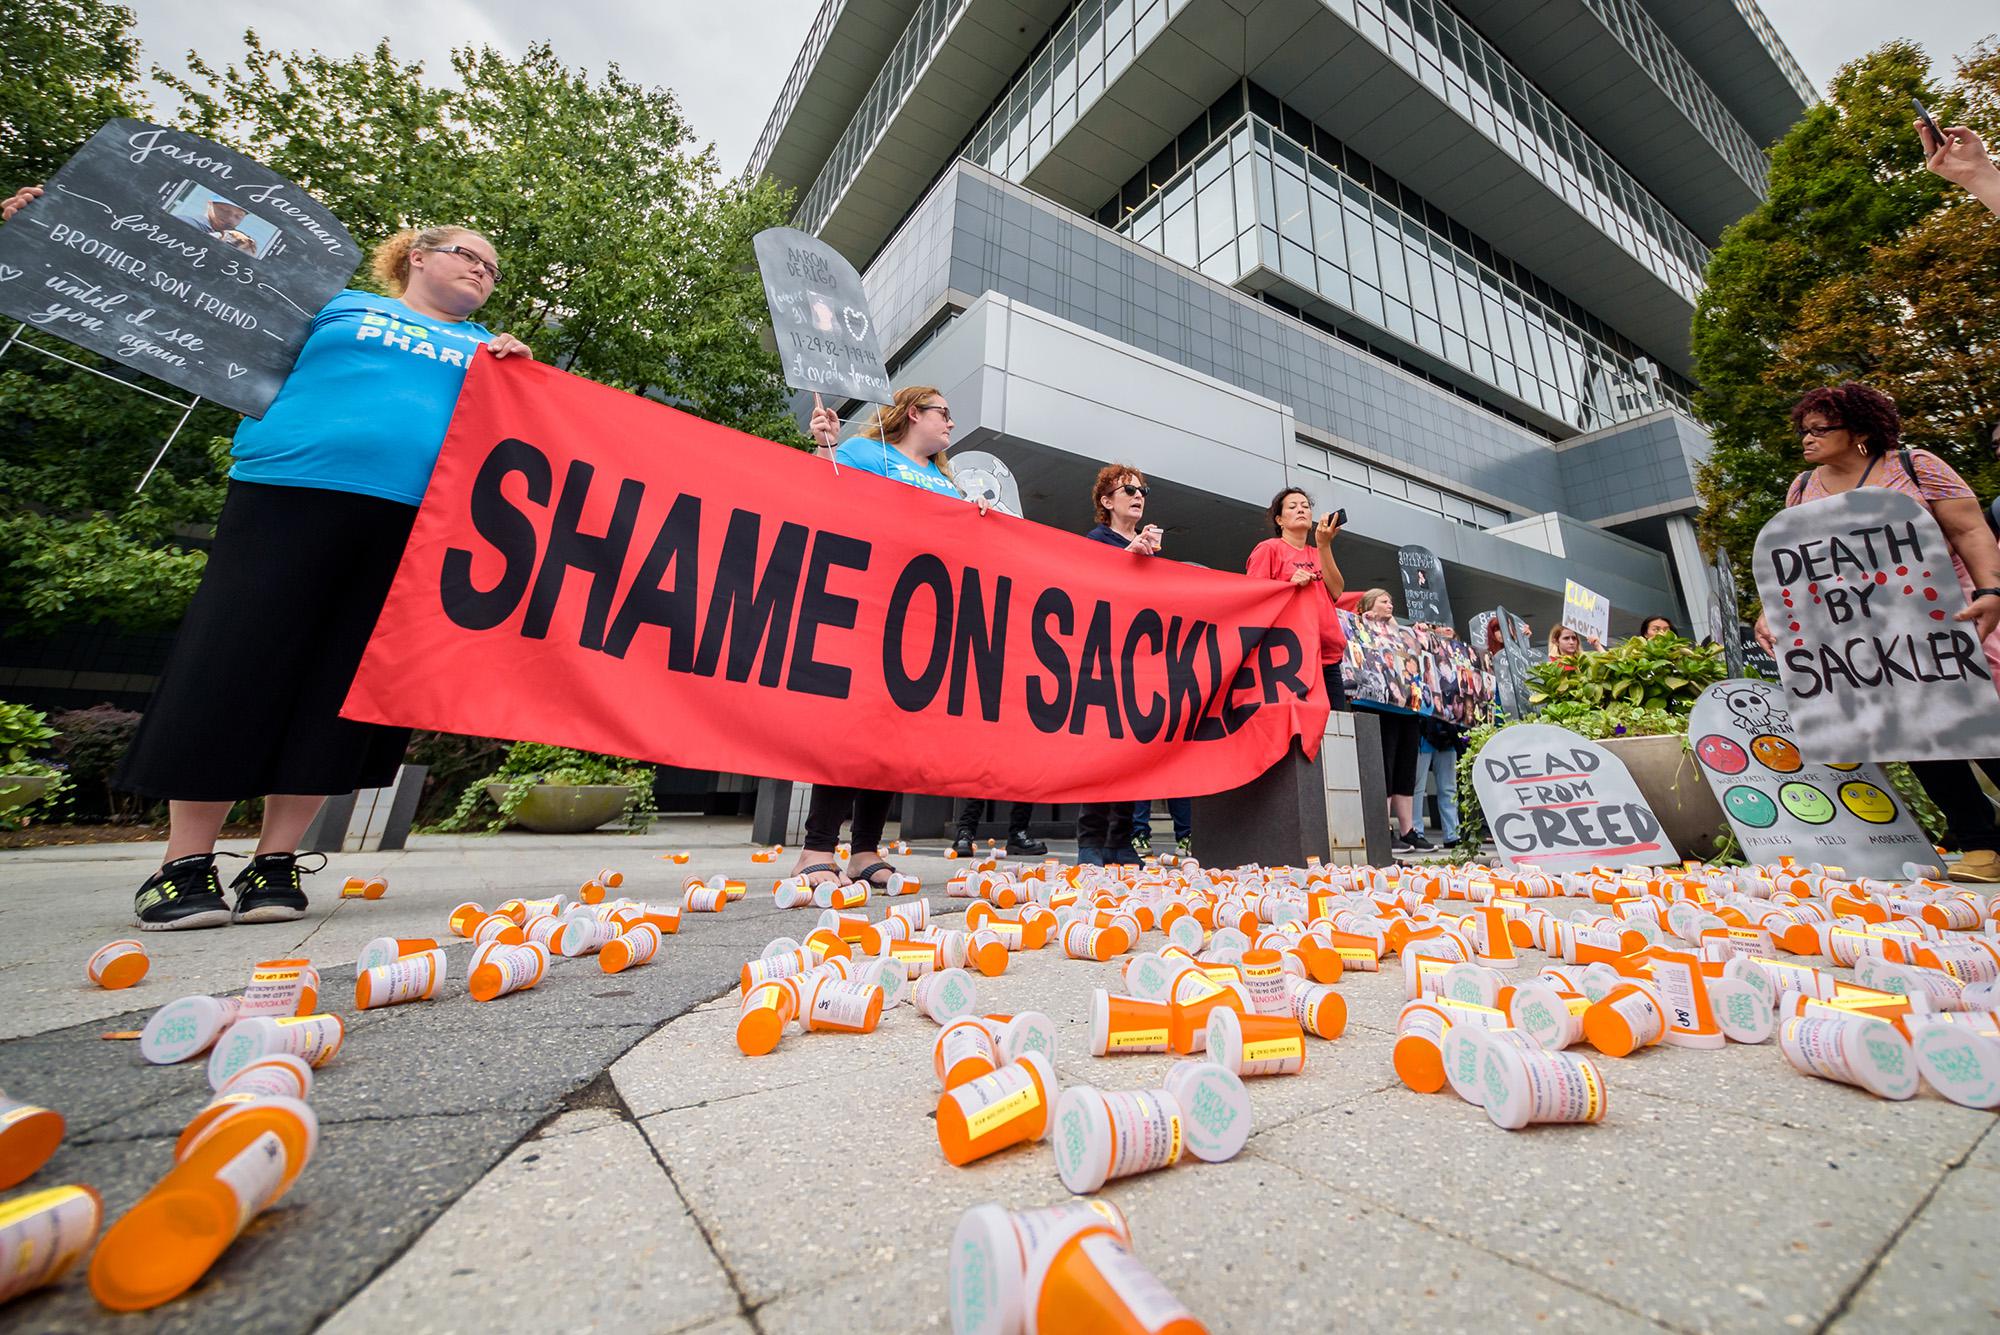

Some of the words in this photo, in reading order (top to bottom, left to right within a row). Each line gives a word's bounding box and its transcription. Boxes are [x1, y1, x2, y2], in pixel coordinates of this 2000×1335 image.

[128, 130, 233, 180] Jason
[111, 213, 209, 268] forever
[219, 259, 254, 285] 33
[786, 247, 830, 272] AARON
[49, 223, 147, 283] BROTHER,
[150, 270, 192, 304] SON,
[195, 291, 259, 331] FRIEND
[786, 261, 838, 289] DERIGO
[28, 300, 105, 334] you
[362, 315, 429, 340] BIG
[155, 324, 205, 353] see
[901, 470, 934, 490] BIG
[1771, 520, 1925, 587] DEATH
[440, 437, 876, 701] SHAME
[882, 552, 1013, 724] ON
[1025, 585, 1310, 746] SACKLER
[1567, 582, 1597, 612] CLAW
[1824, 582, 1876, 625] BY
[1784, 629, 1992, 700] SACKLER
[1746, 727, 1760, 737] NO
[1768, 722, 1795, 736] PAIN
[1485, 748, 1601, 784] DEAD
[1830, 772, 1873, 783] SEVERE
[1514, 780, 1595, 806] FROM
[1494, 802, 1661, 853] GREED
[1746, 834, 1792, 847] PAINLESS
[1814, 835, 1847, 846] MILD
[1868, 834, 1921, 845] MODERATE
